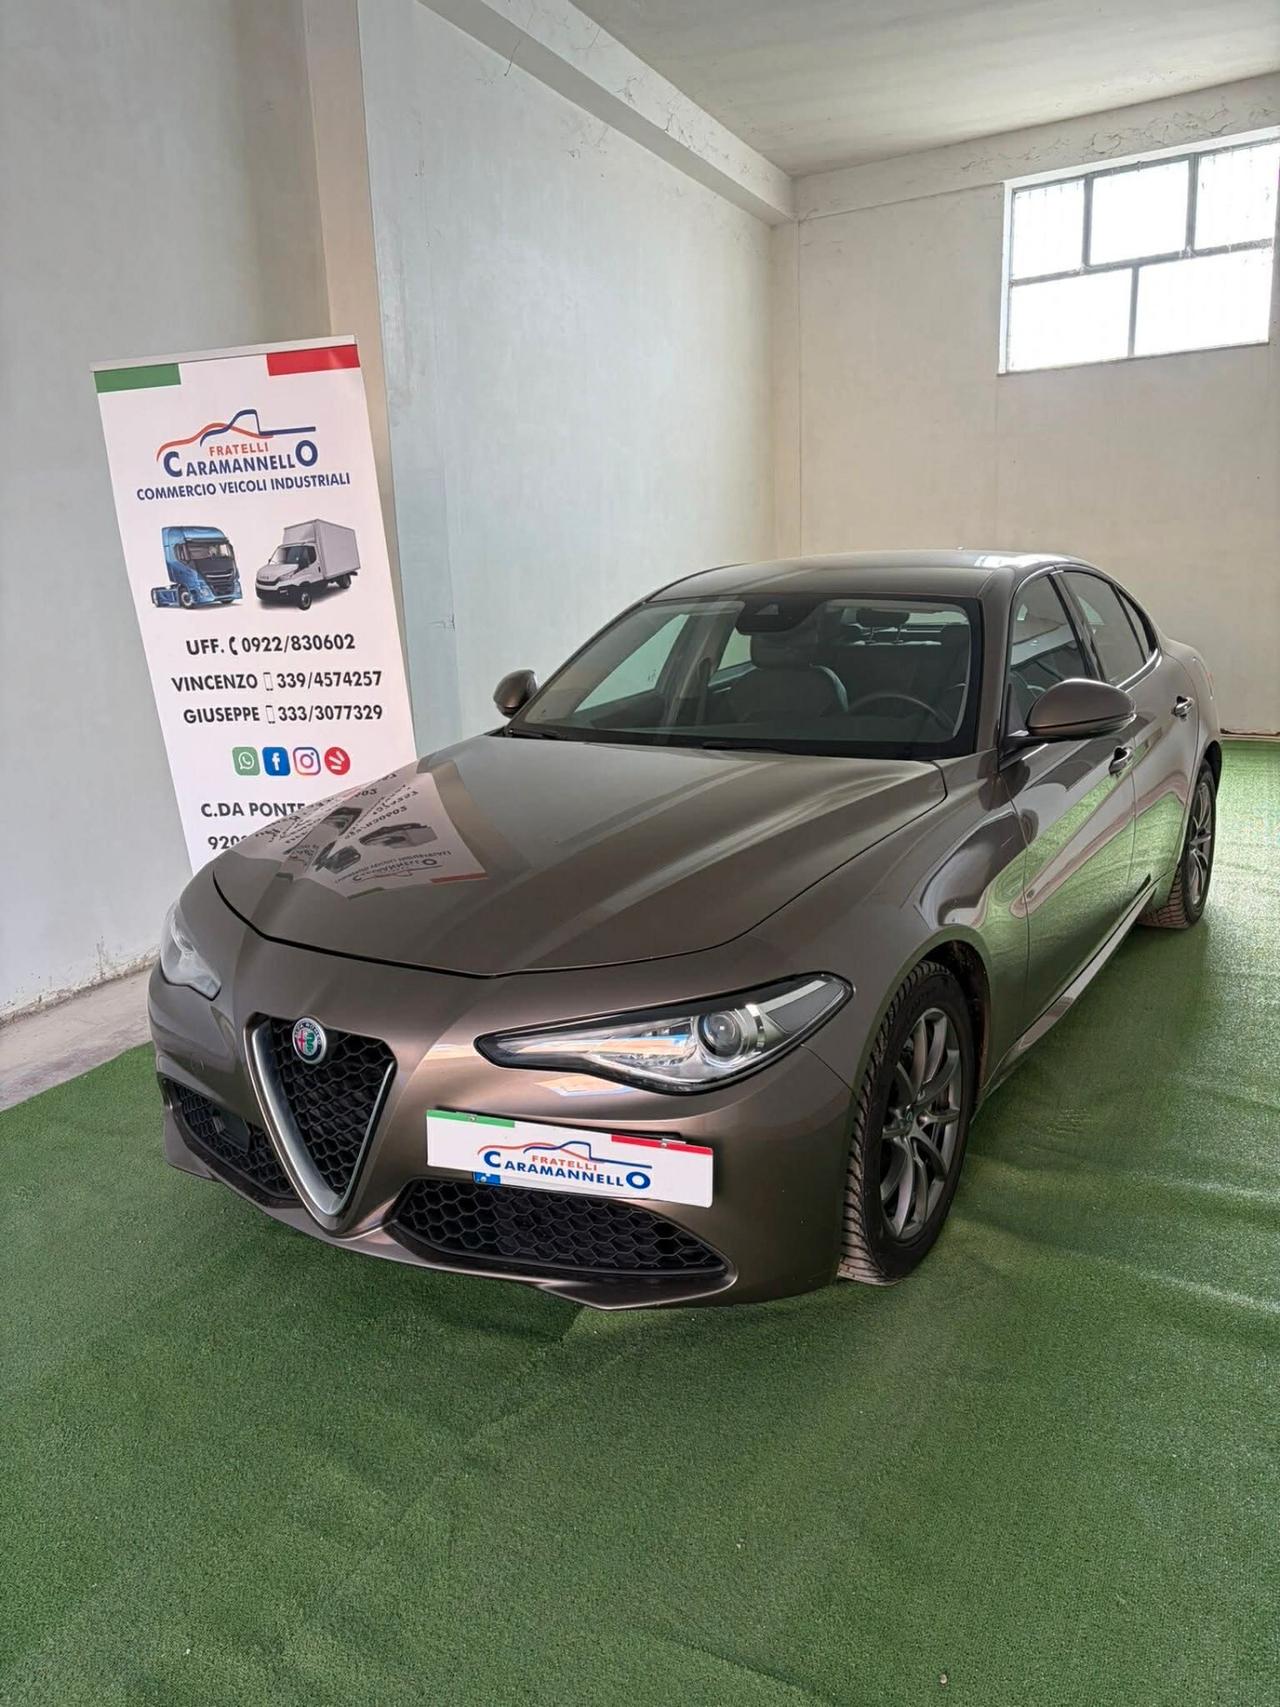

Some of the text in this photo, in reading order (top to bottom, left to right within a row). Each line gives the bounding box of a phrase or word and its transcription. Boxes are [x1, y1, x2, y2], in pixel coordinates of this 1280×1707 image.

[163, 440, 318, 477] CARAMANNELLO
[209, 441, 269, 457] FRATELLI
[136, 472, 351, 501] COMMERCIO VEICOLI INDUSTRIALI
[186, 633, 356, 655] UFF. 0922/830602
[171, 670, 382, 692] VINCENZO 339/4574257
[183, 704, 383, 724] GIUSEPPE 333/3077329
[200, 802, 245, 818] C.DA
[483, 1150, 651, 1190] CARAMANNELLO
[531, 1154, 598, 1171] FRATELLI
